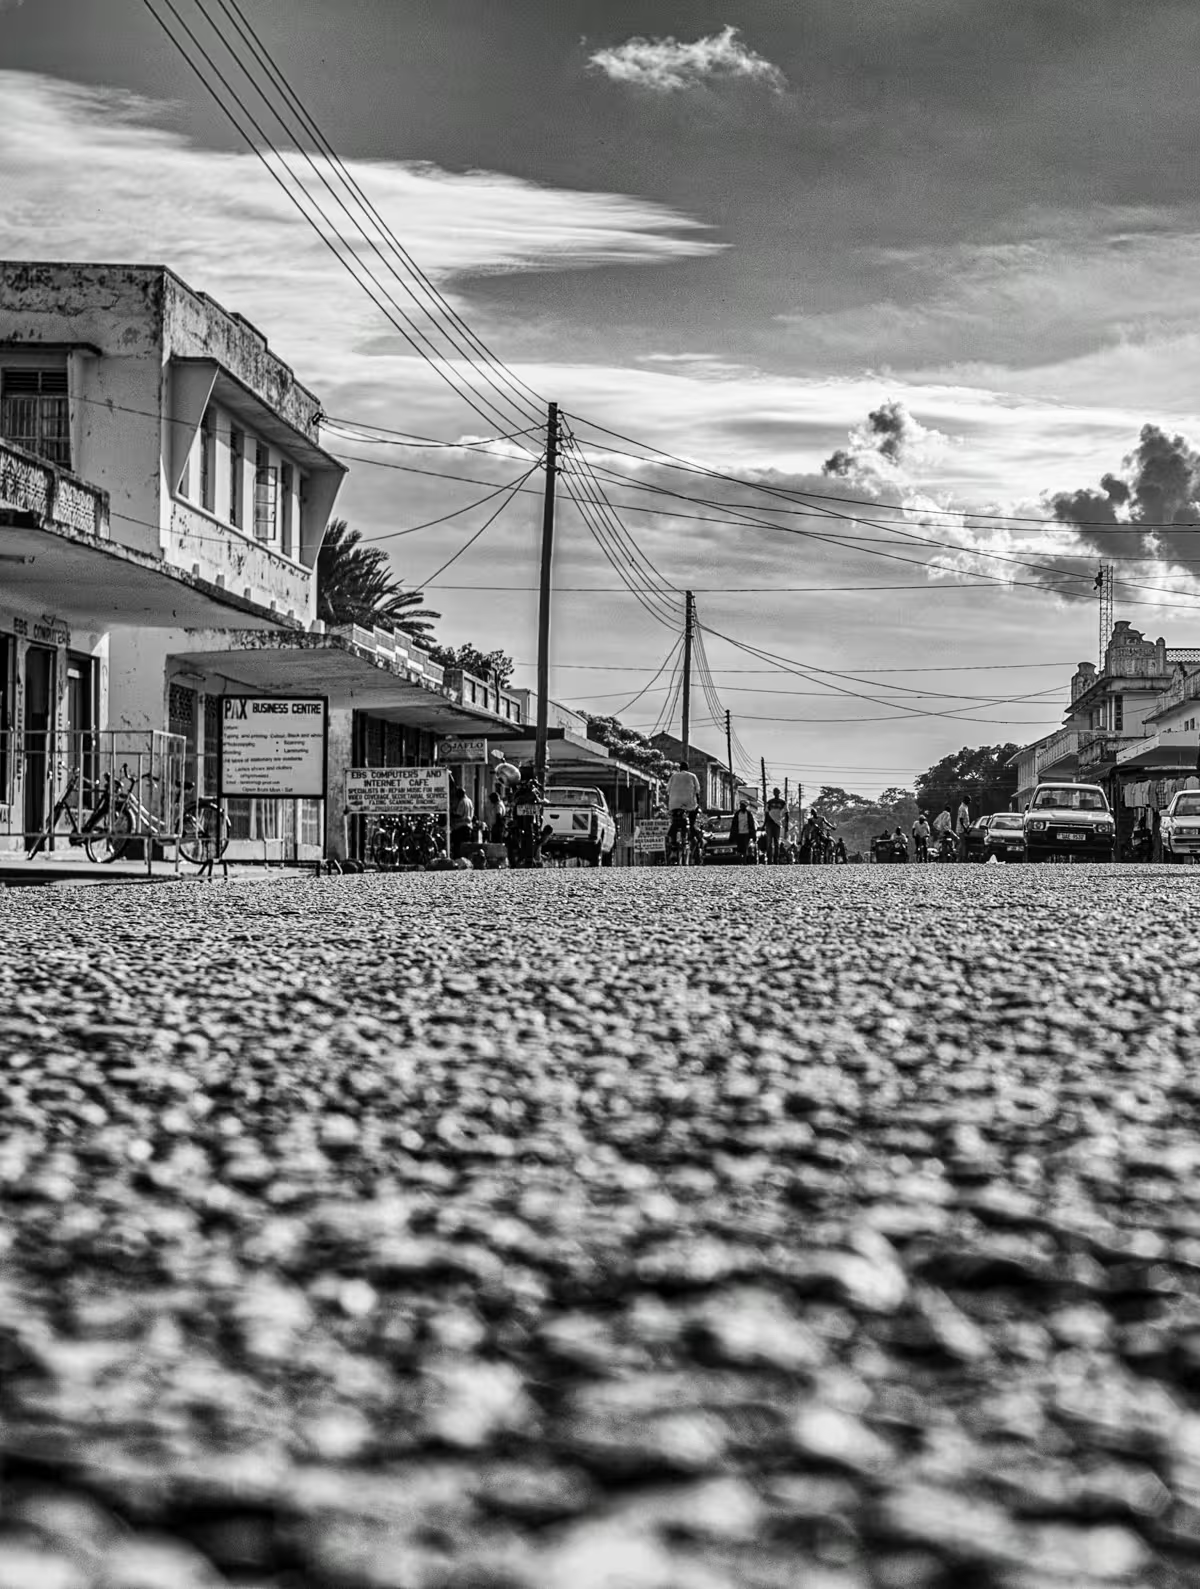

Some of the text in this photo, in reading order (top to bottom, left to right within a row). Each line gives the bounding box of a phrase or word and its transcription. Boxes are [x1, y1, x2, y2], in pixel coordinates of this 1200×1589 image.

[252, 703, 288, 714] BUSINESS
[291, 703, 321, 714] CENTRE
[371, 770, 419, 779] COMPUTERS
[426, 770, 442, 778] AND
[364, 779, 401, 787] INTERNET
